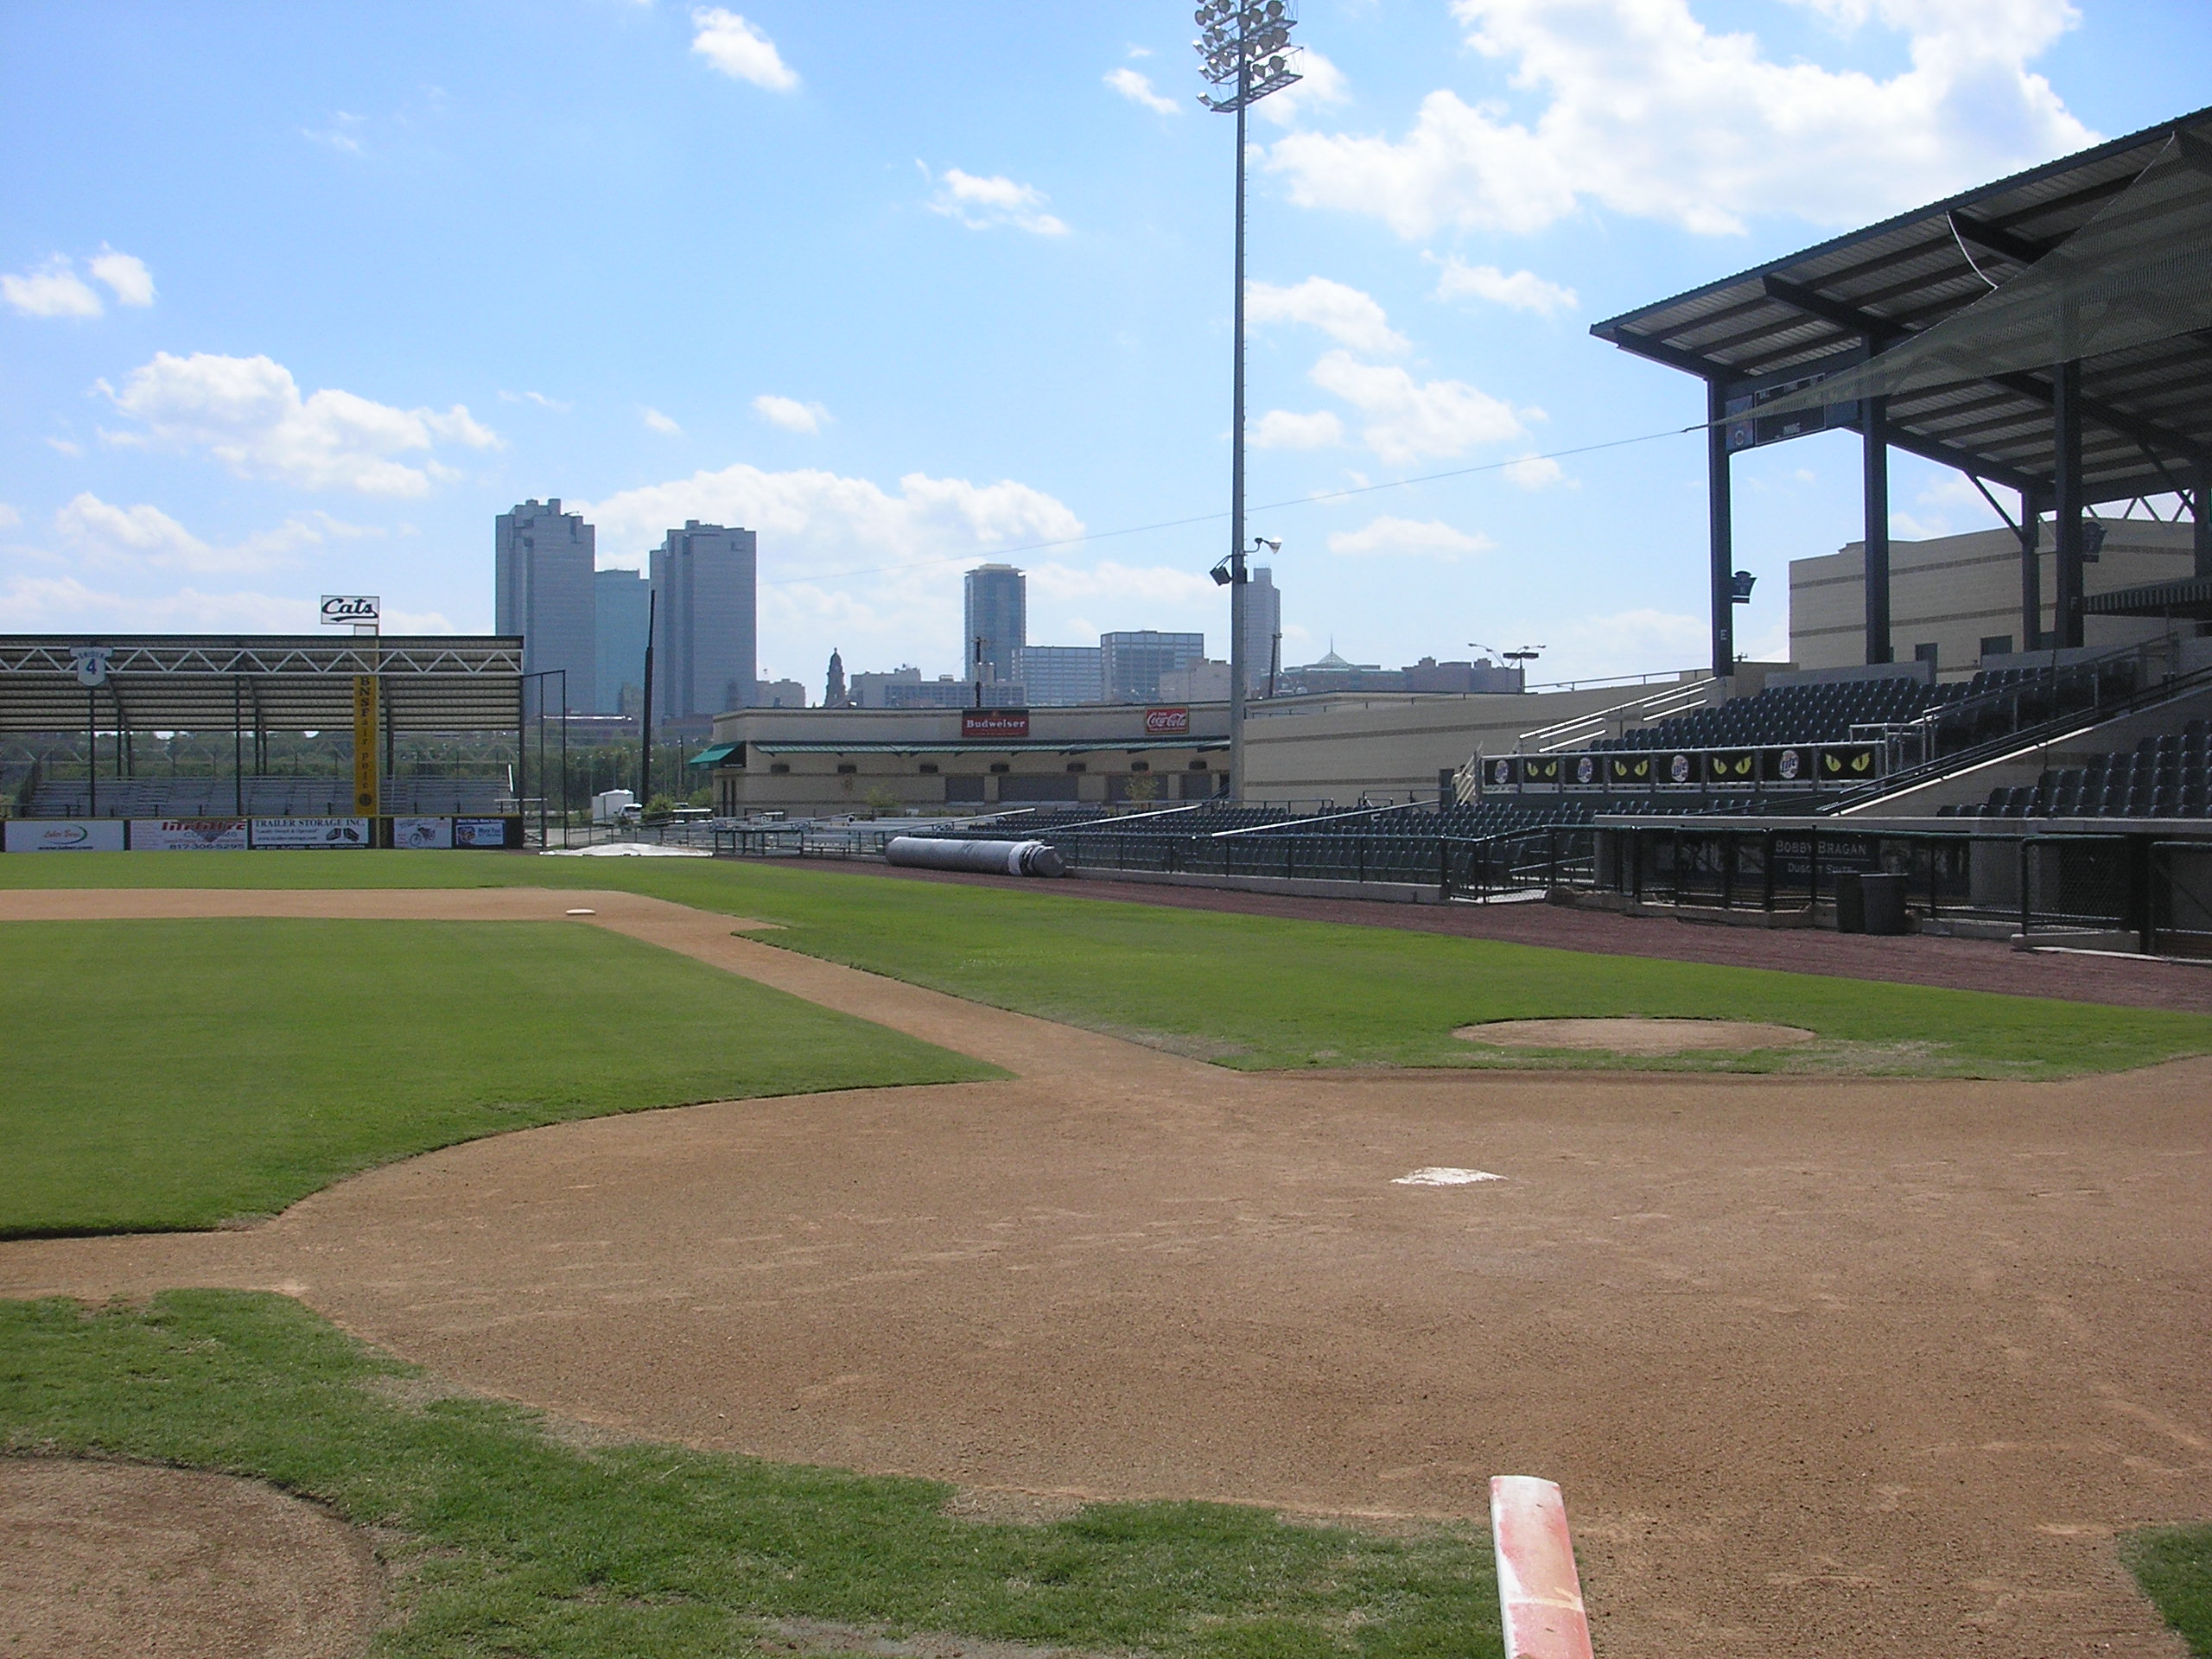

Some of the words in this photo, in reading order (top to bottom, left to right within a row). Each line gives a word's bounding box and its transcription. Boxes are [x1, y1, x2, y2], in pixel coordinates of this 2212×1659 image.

[321, 598, 378, 622] Cats
[86, 658, 97, 675] 4
[967, 719, 1026, 728] Budweiser
[1818, 841, 1866, 855] BRAGAN
